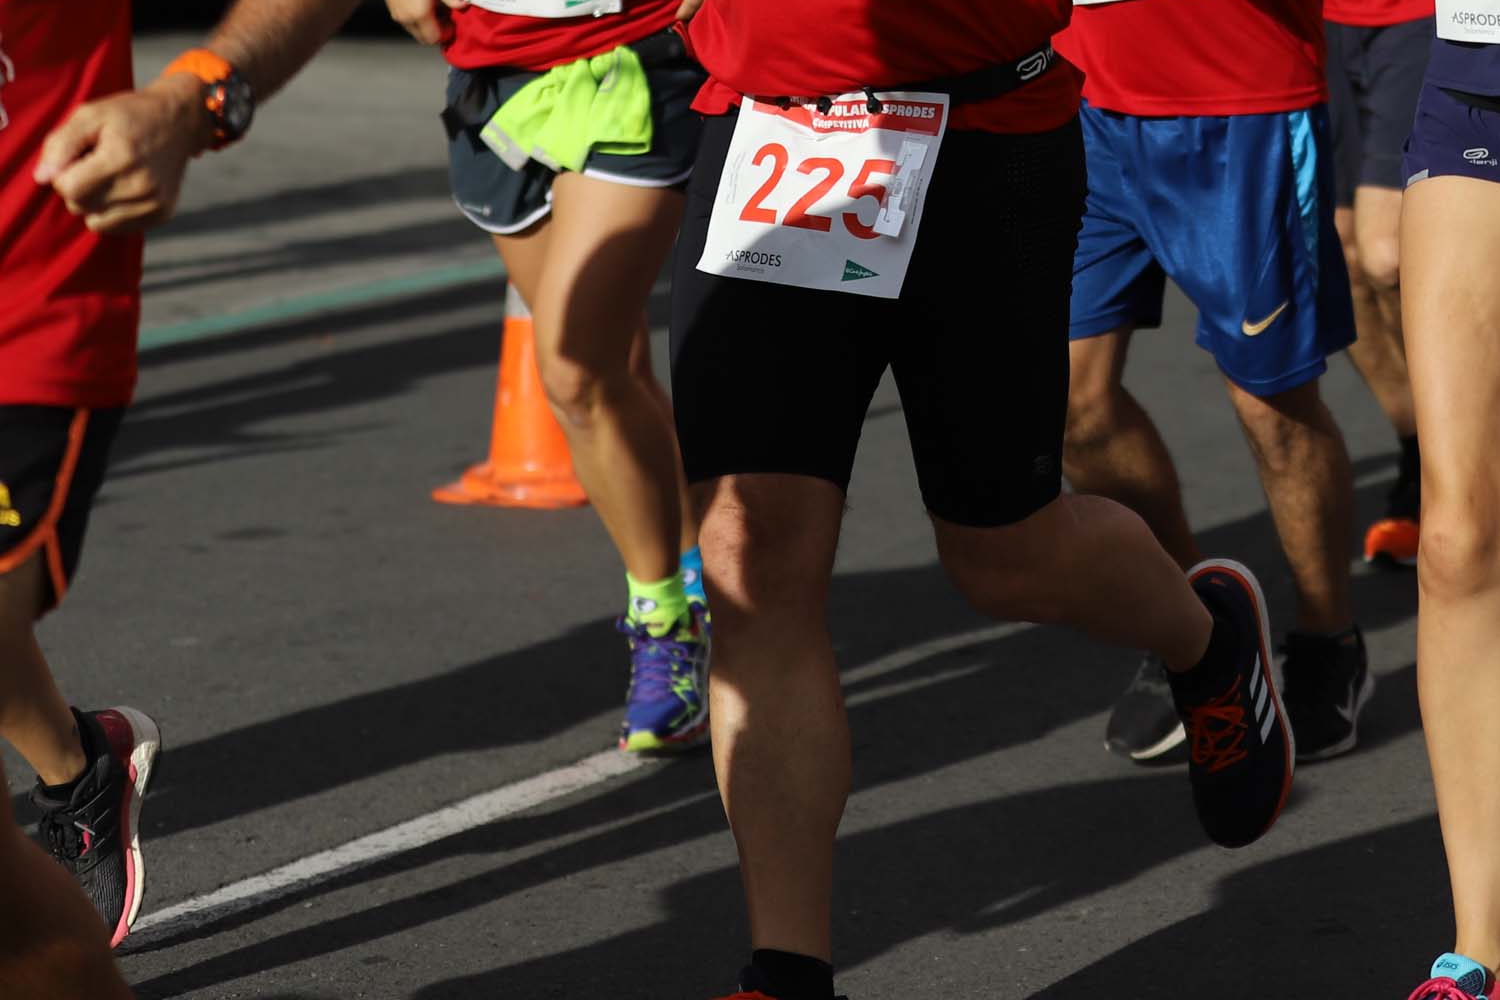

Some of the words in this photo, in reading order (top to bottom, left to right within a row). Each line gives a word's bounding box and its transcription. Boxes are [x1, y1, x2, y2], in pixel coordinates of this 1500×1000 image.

[830, 104, 868, 118] PULAR
[882, 104, 935, 119] SPRODES
[739, 142, 900, 240] 225
[726, 249, 782, 267] ASPRODES
